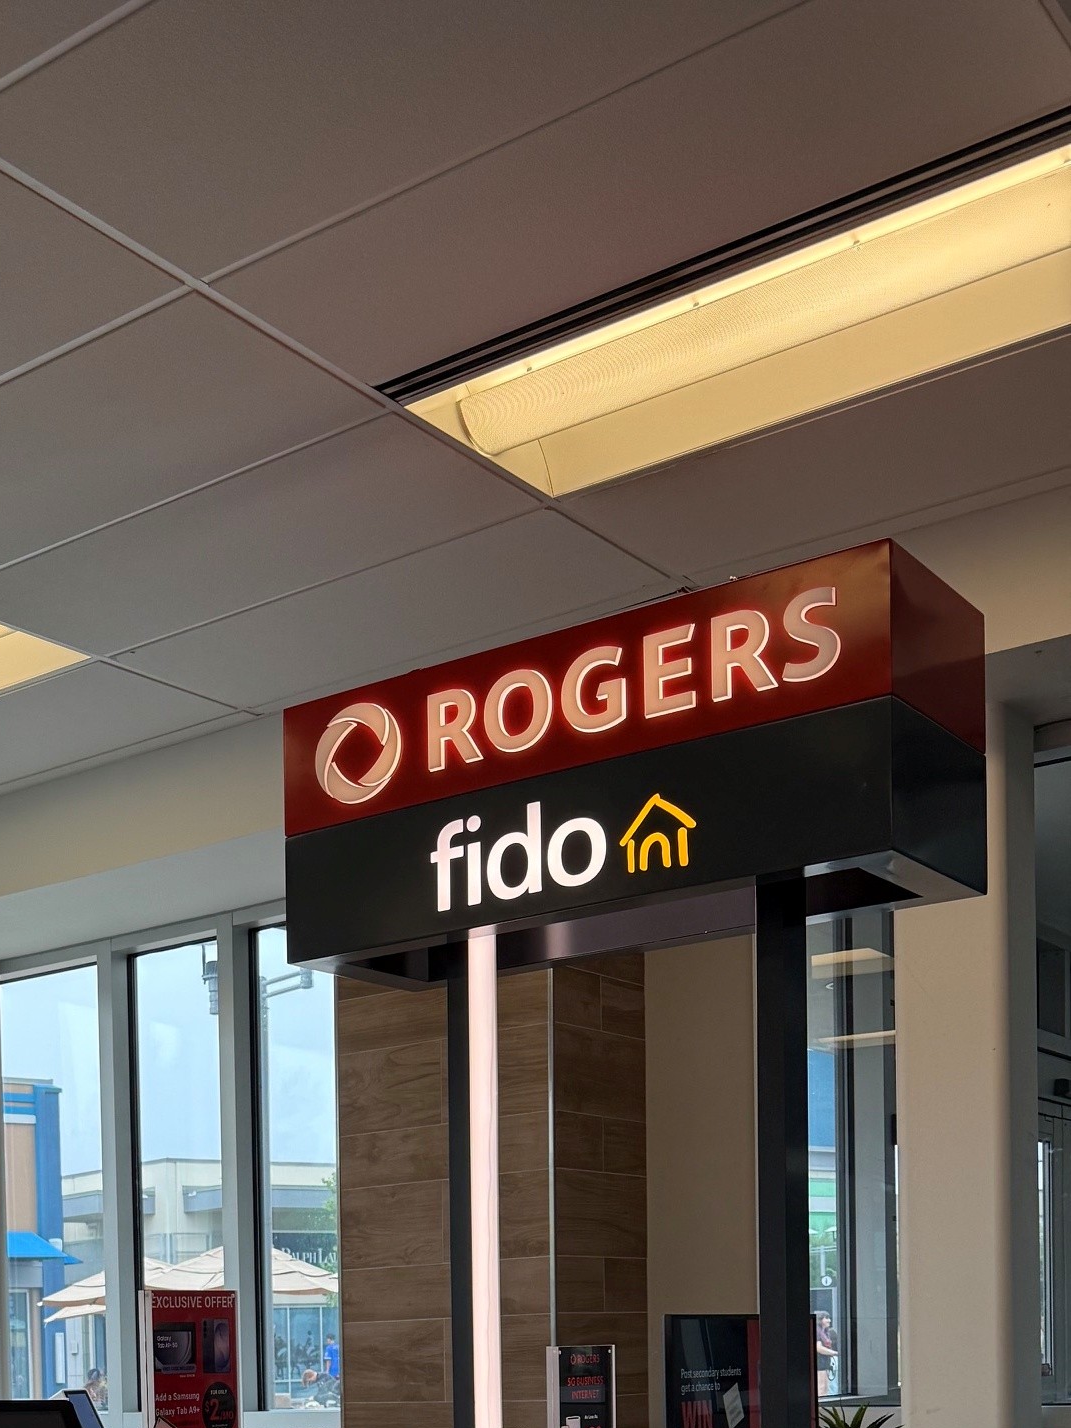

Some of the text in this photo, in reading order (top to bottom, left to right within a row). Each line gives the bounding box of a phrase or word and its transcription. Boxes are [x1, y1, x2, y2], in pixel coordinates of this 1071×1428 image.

[427, 586, 841, 773] ROGERS
[429, 800, 607, 912] fido
[151, 1296, 233, 1309] EXCLUSIVE OFFER
[720, 1365, 742, 1377] students
[155, 1393, 166, 1401] Add
[172, 1392, 200, 1403] Samsung
[155, 1407, 175, 1418] Galaxy
[176, 1408, 187, 1416] Tab
